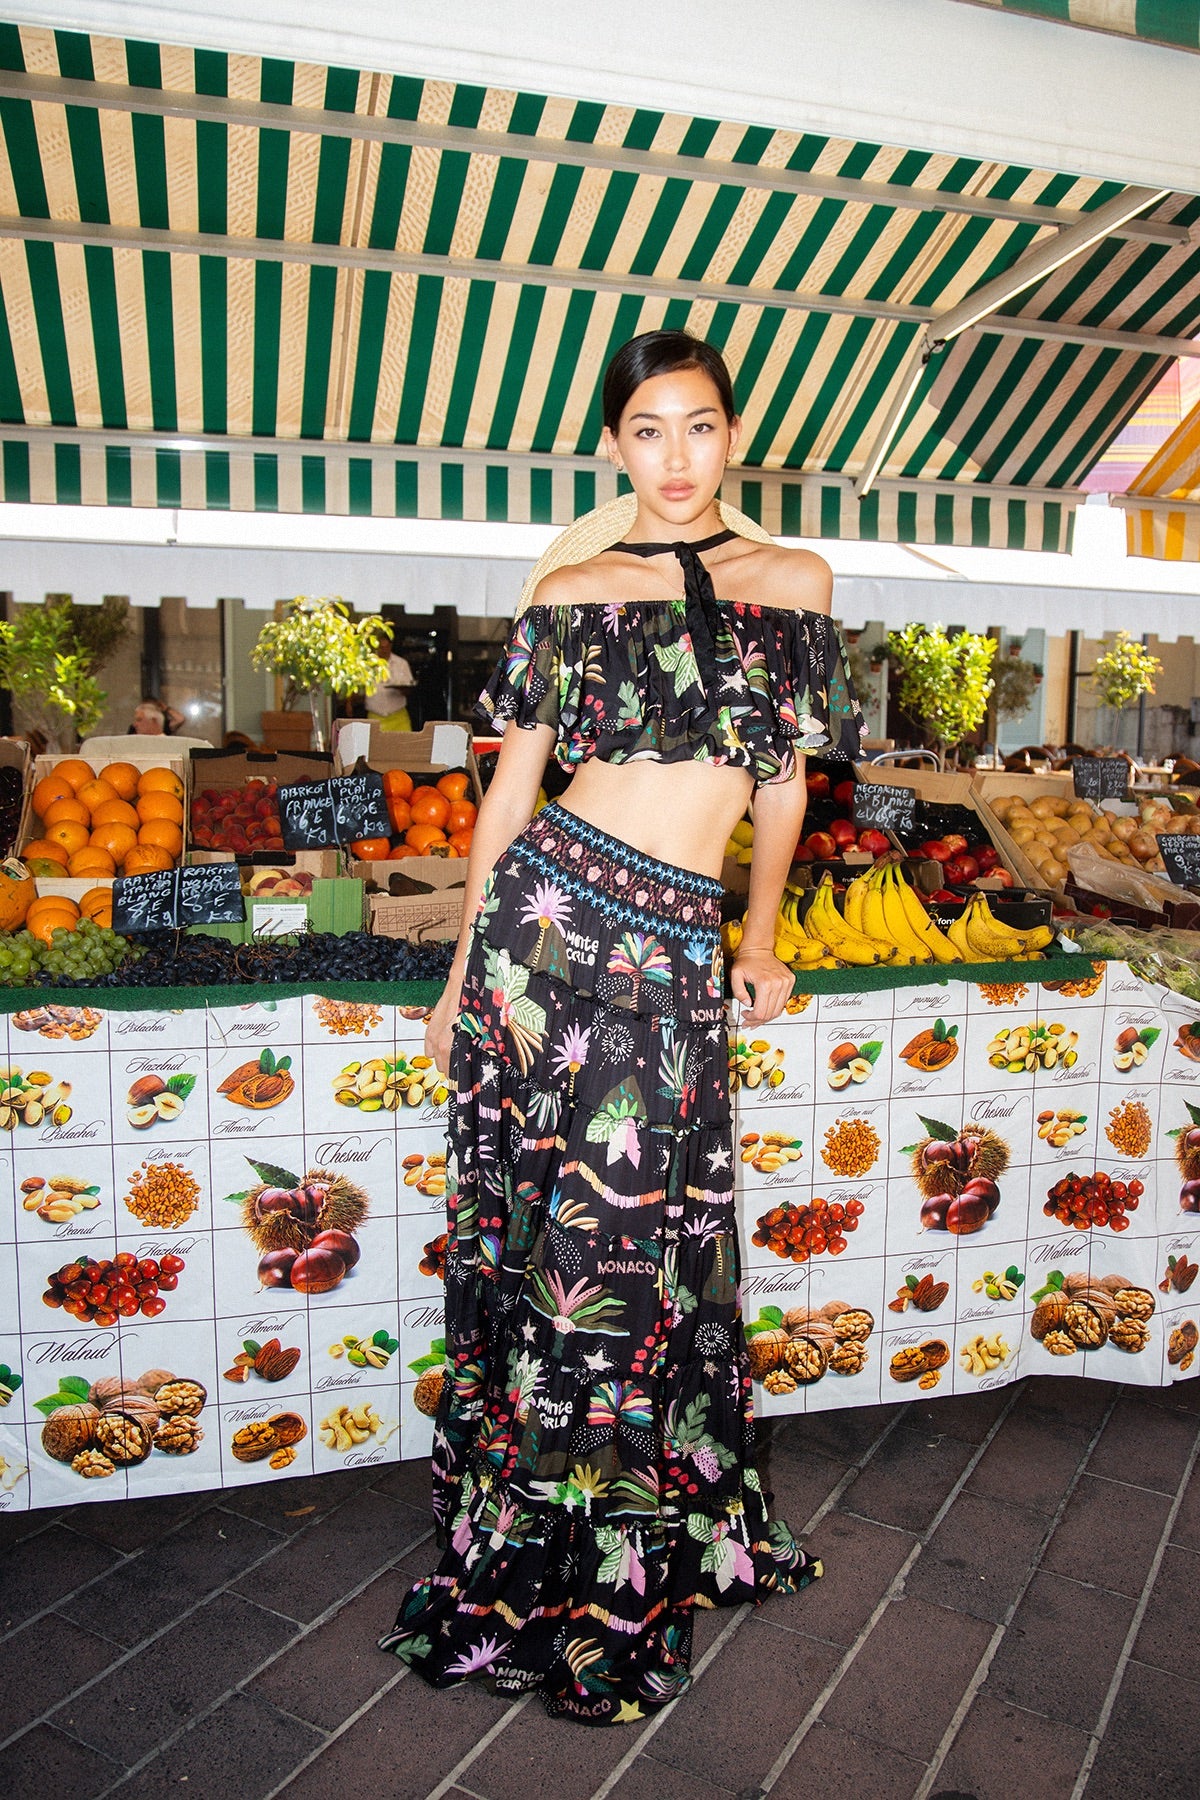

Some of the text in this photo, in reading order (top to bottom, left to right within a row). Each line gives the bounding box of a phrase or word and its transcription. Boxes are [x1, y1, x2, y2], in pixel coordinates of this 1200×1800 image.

[126, 1054, 200, 1073] Hazelnut
[315, 1136, 392, 1166] Chesnut
[53, 1220, 111, 1238] Peanut
[597, 1260, 656, 1275] MONACO
[741, 1268, 825, 1296] Walnut
[27, 1332, 139, 1364] Walnut
[557, 1698, 611, 1717] ONACO
